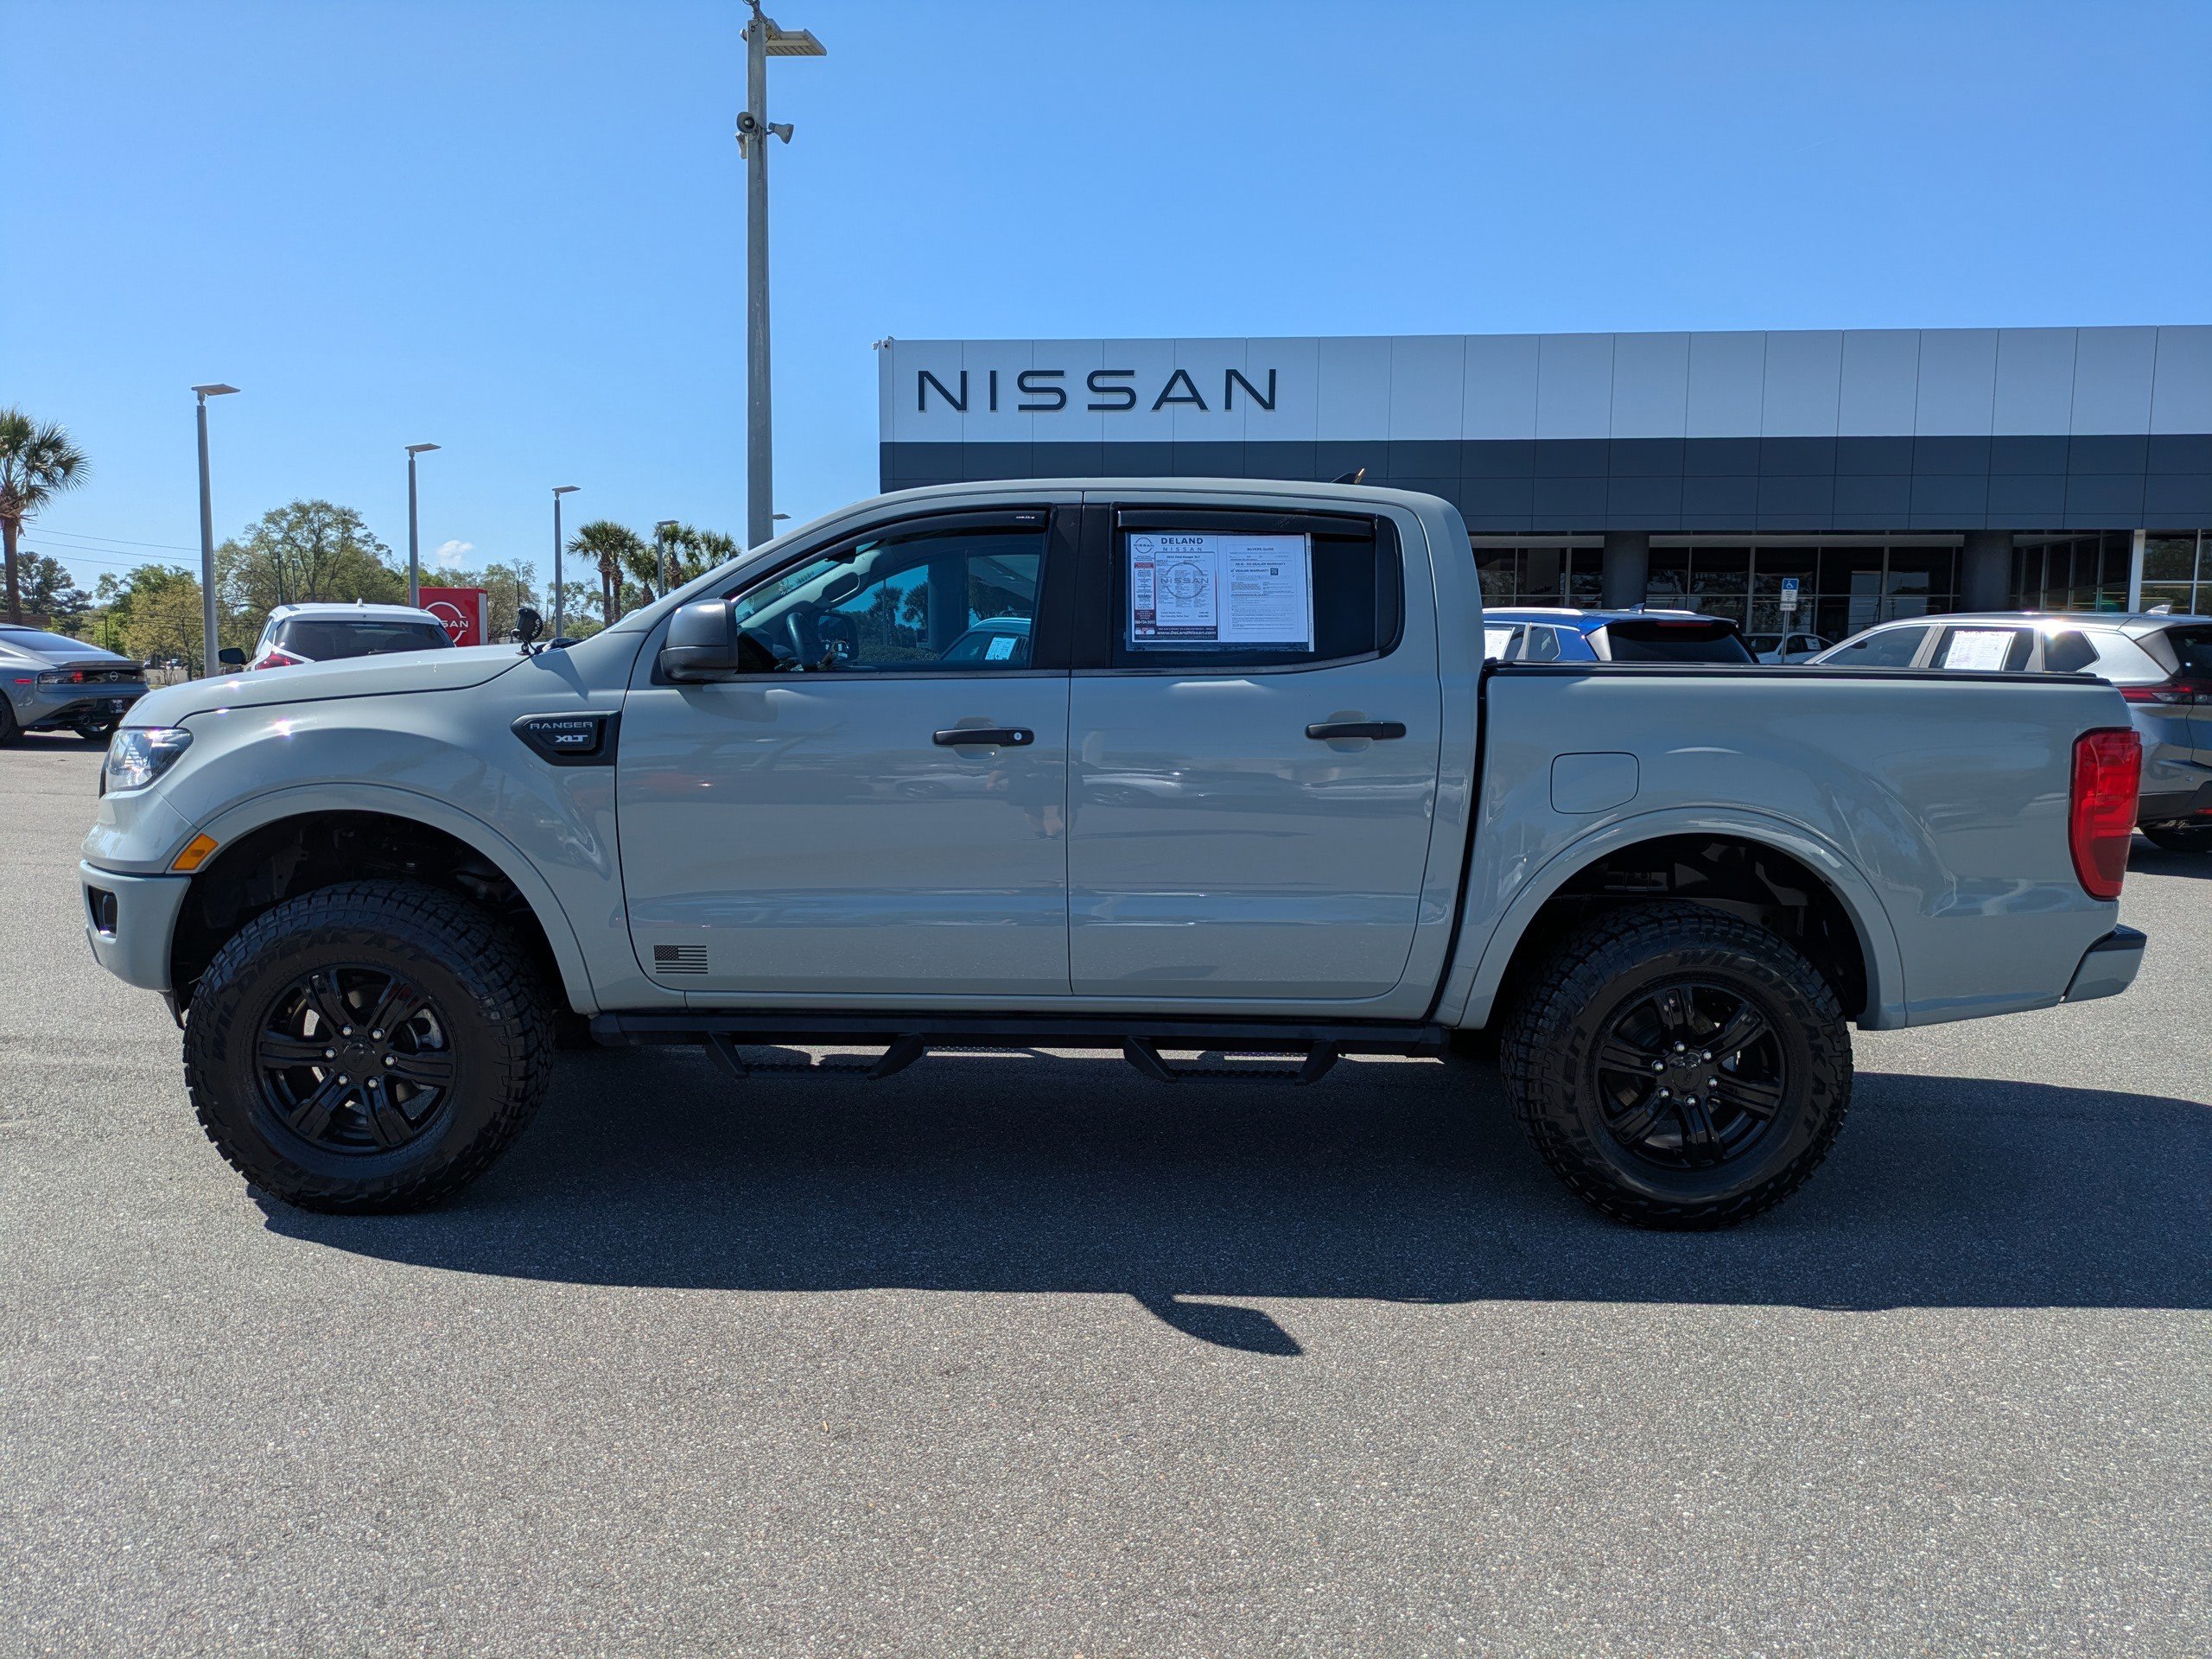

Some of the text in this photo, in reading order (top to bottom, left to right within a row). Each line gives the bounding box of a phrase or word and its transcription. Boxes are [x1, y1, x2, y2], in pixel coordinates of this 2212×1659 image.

[918, 368, 1277, 412] NISSAN
[530, 721, 594, 729] RANGER
[555, 734, 588, 743] XLT
[1677, 950, 1829, 1070] WILDPEAK
